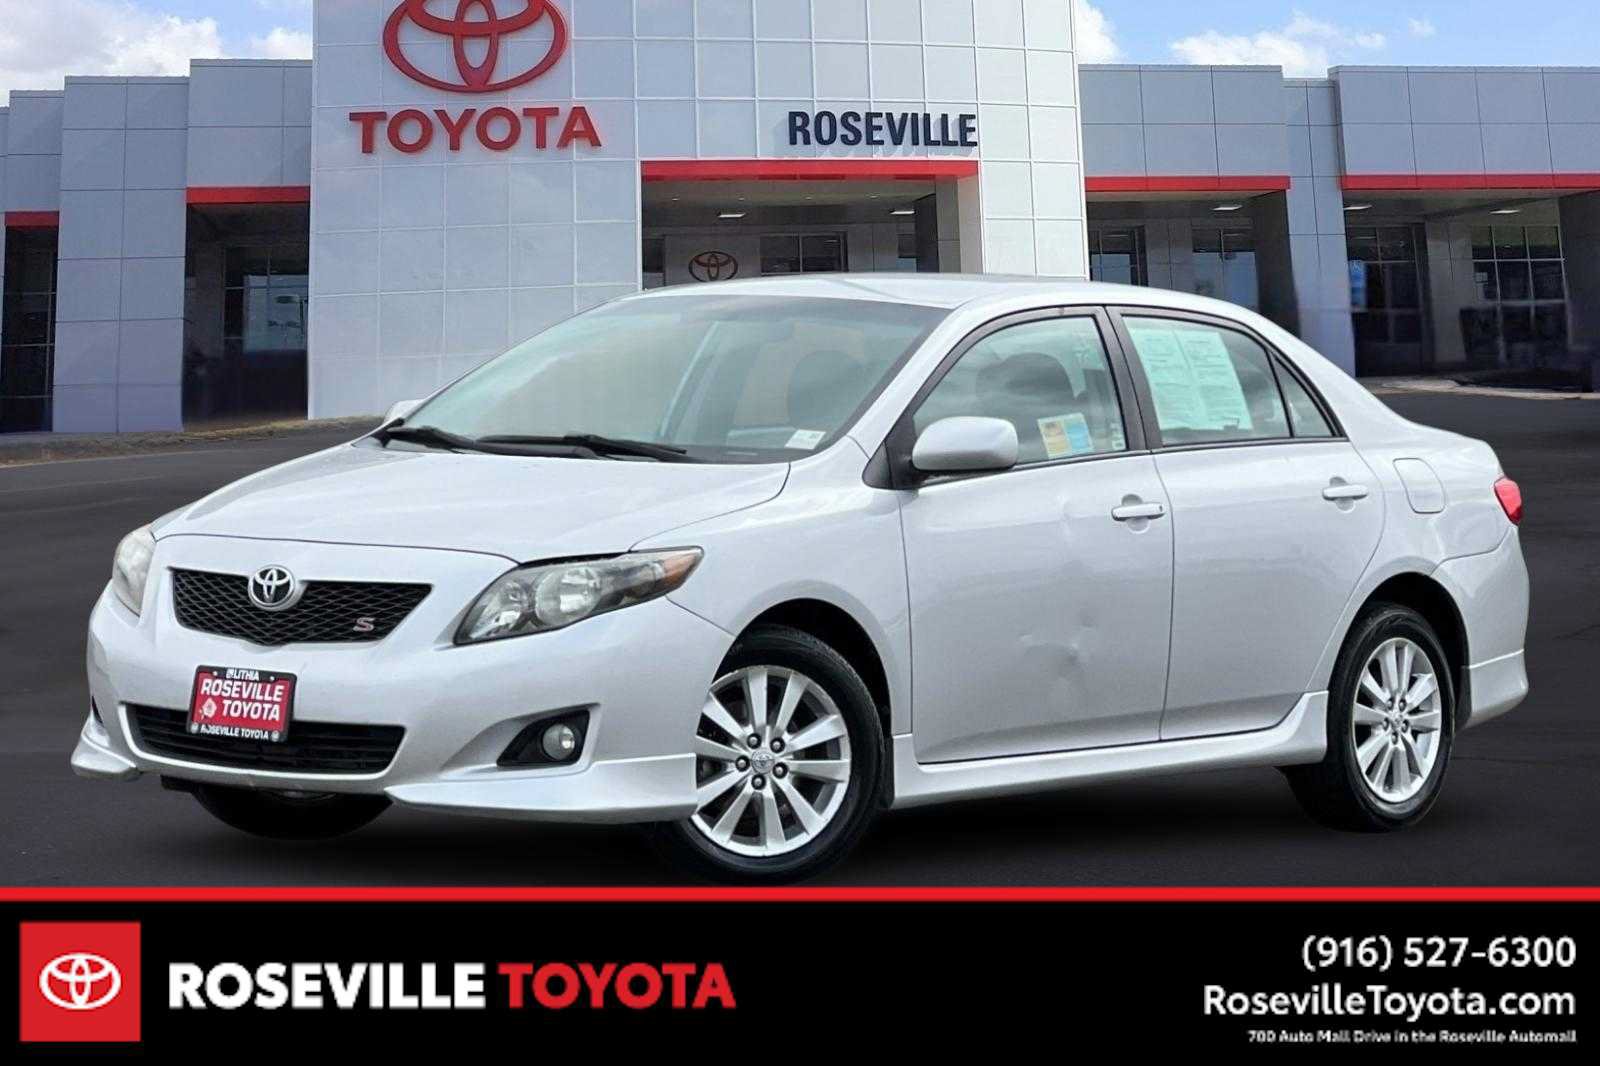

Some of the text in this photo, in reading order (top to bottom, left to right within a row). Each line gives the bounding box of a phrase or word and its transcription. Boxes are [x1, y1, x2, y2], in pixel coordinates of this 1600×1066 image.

[350, 106, 603, 154] TOYOTA
[788, 110, 978, 147] ROSEVILLE
[353, 616, 375, 632] S
[234, 669, 260, 681] LITHIA
[201, 679, 284, 702] ROSEVILLE
[222, 700, 280, 721] TOYOTA
[241, 728, 270, 740] TOYOTA
